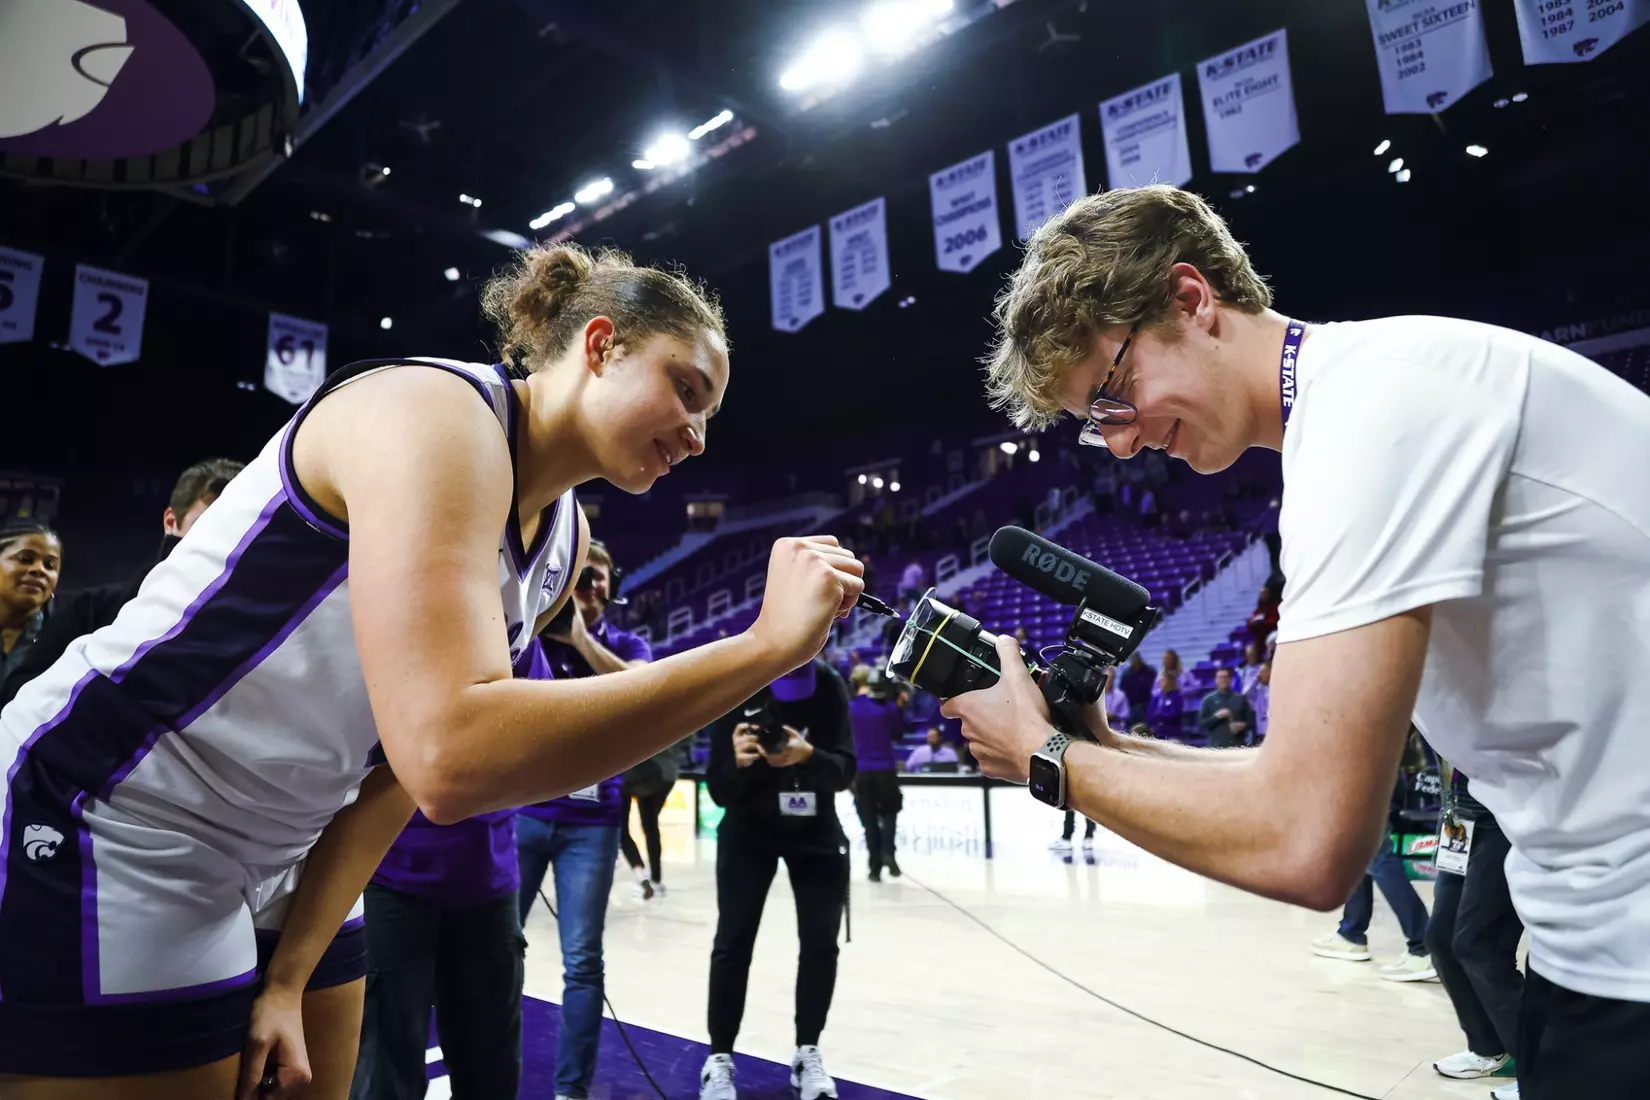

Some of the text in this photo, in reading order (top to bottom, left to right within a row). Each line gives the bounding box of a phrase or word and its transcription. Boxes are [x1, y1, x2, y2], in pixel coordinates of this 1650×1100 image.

[1379, 21, 1418, 46] SWEET
[1421, 0, 1475, 29] SIXTEEN
[1541, 8, 1574, 26] 1984
[1543, 20, 1575, 39] 1987
[1589, 2, 1624, 23] 2004
[944, 224, 988, 254] 2006
[92, 291, 124, 337] 2
[276, 332, 315, 371] 61
[1282, 344, 1297, 407] K-STATE
[1022, 543, 1091, 592] RØDE
[1083, 610, 1131, 635] KSTATE HDTV
